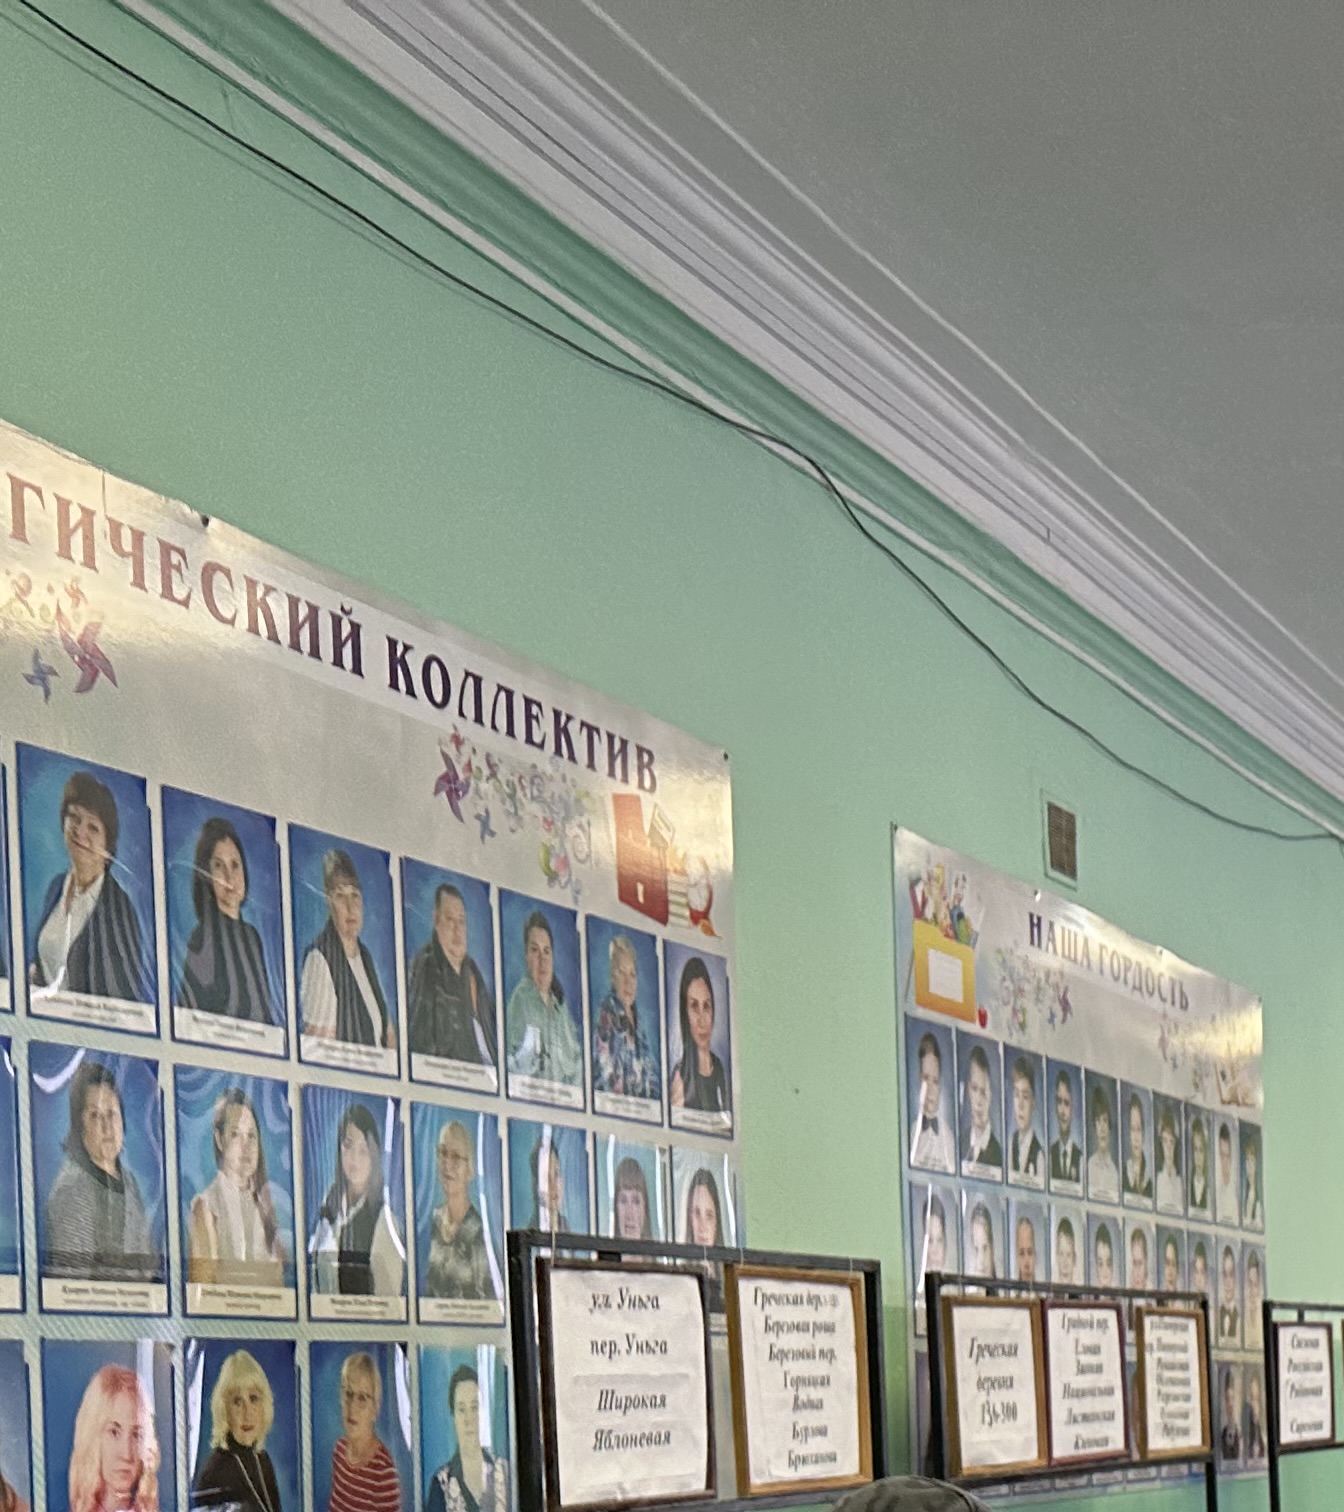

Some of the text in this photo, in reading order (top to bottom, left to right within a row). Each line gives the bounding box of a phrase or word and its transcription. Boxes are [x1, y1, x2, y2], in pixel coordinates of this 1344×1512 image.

[6, 472, 658, 794] ГИЧЕСКИЙ КОЛЛЕКТИВ
[1028, 911, 1190, 1013] НАША ГОРДОСТЬ
[616, 1286, 662, 1311] Уньга
[590, 1332, 669, 1361] пер. Уньга
[597, 1387, 668, 1417] Широкая
[592, 1428, 672, 1453] Яблоневая
